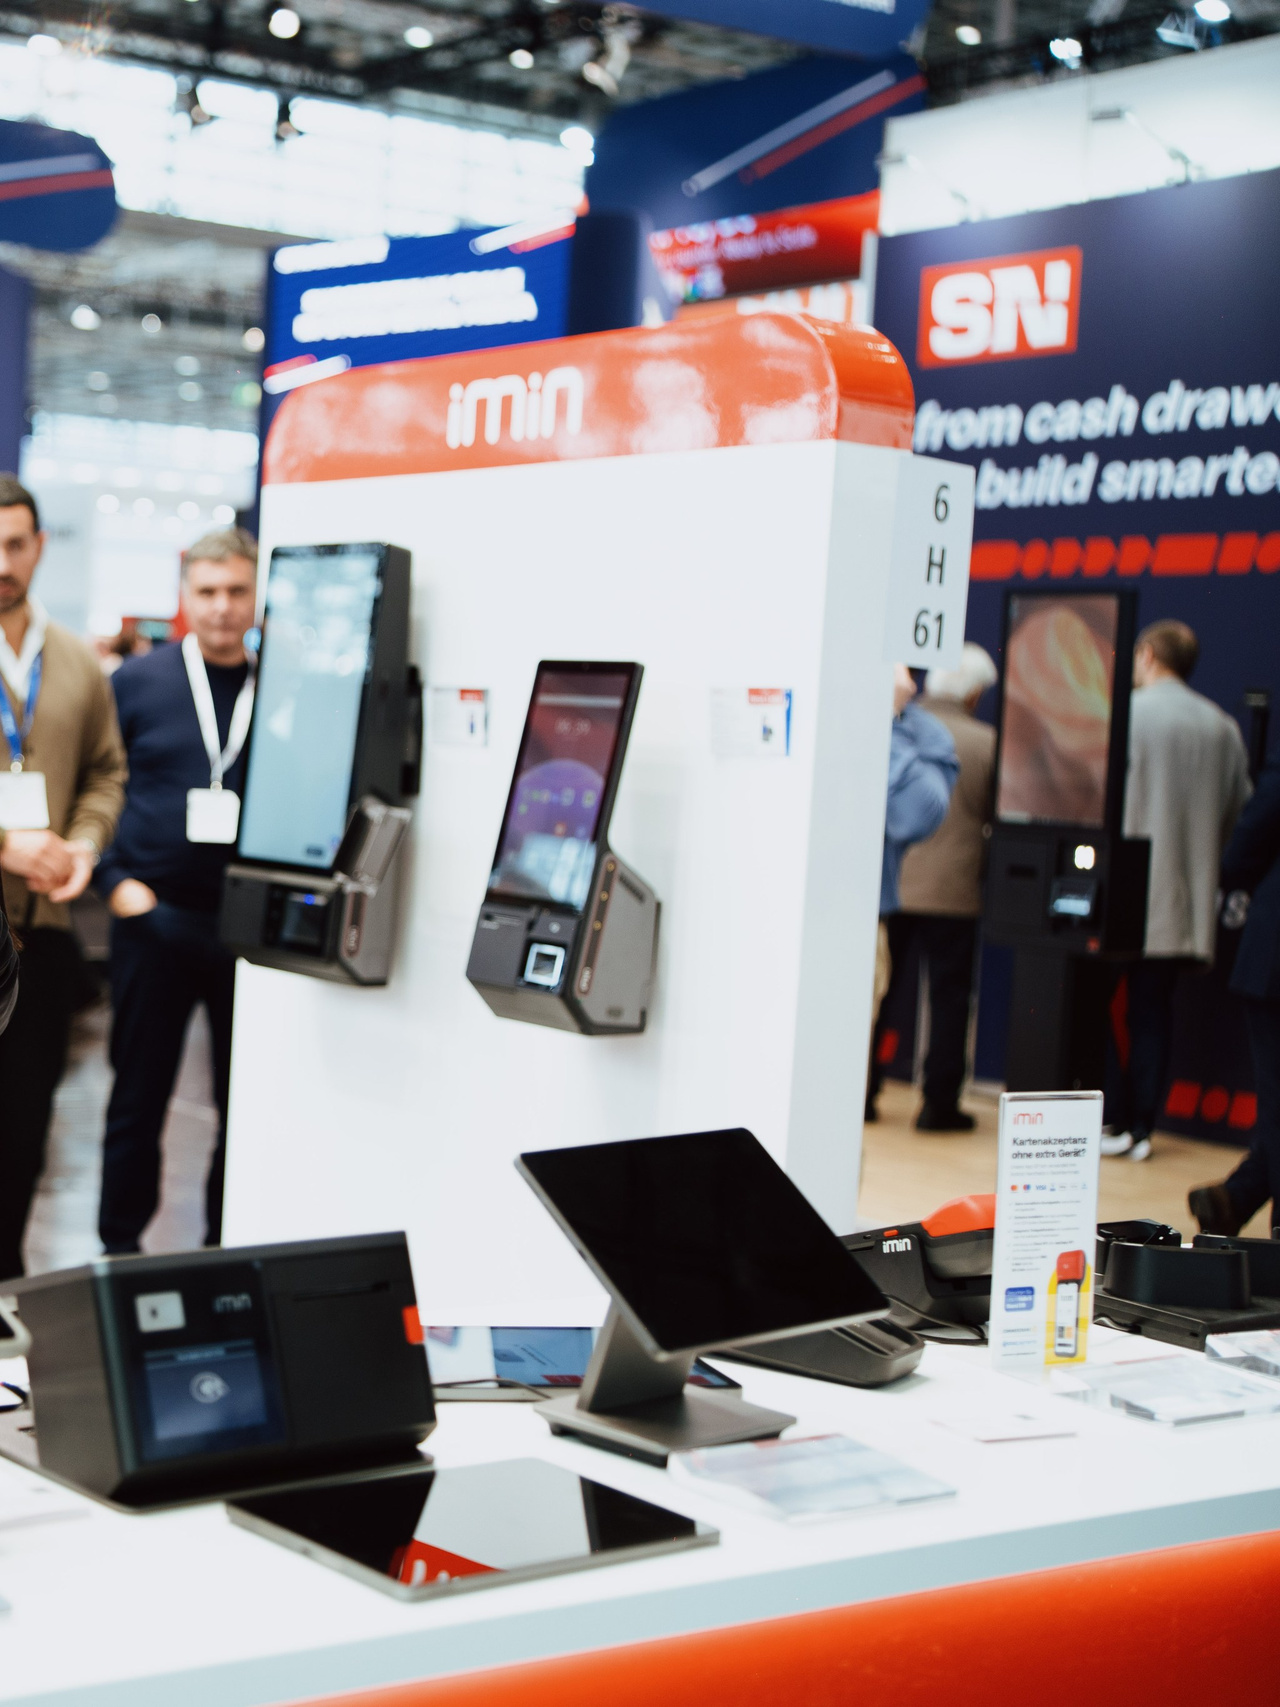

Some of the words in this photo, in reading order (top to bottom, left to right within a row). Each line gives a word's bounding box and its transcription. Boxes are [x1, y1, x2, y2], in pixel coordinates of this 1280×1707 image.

[927, 257, 1072, 361] SN
[913, 398, 1024, 452] from
[1024, 383, 1140, 444] cash
[1141, 378, 1280, 435] draw
[975, 451, 1100, 510] build
[1097, 444, 1280, 503] smarte
[932, 483, 950, 523] 6
[926, 544, 947, 586] H
[912, 607, 945, 651] 61
[1011, 1150, 1033, 1160] ohne
[1035, 1149, 1057, 1159] extra
[1058, 1147, 1087, 1158] Gerät?
[1012, 1136, 1088, 1147] Kartenakzeptanz
